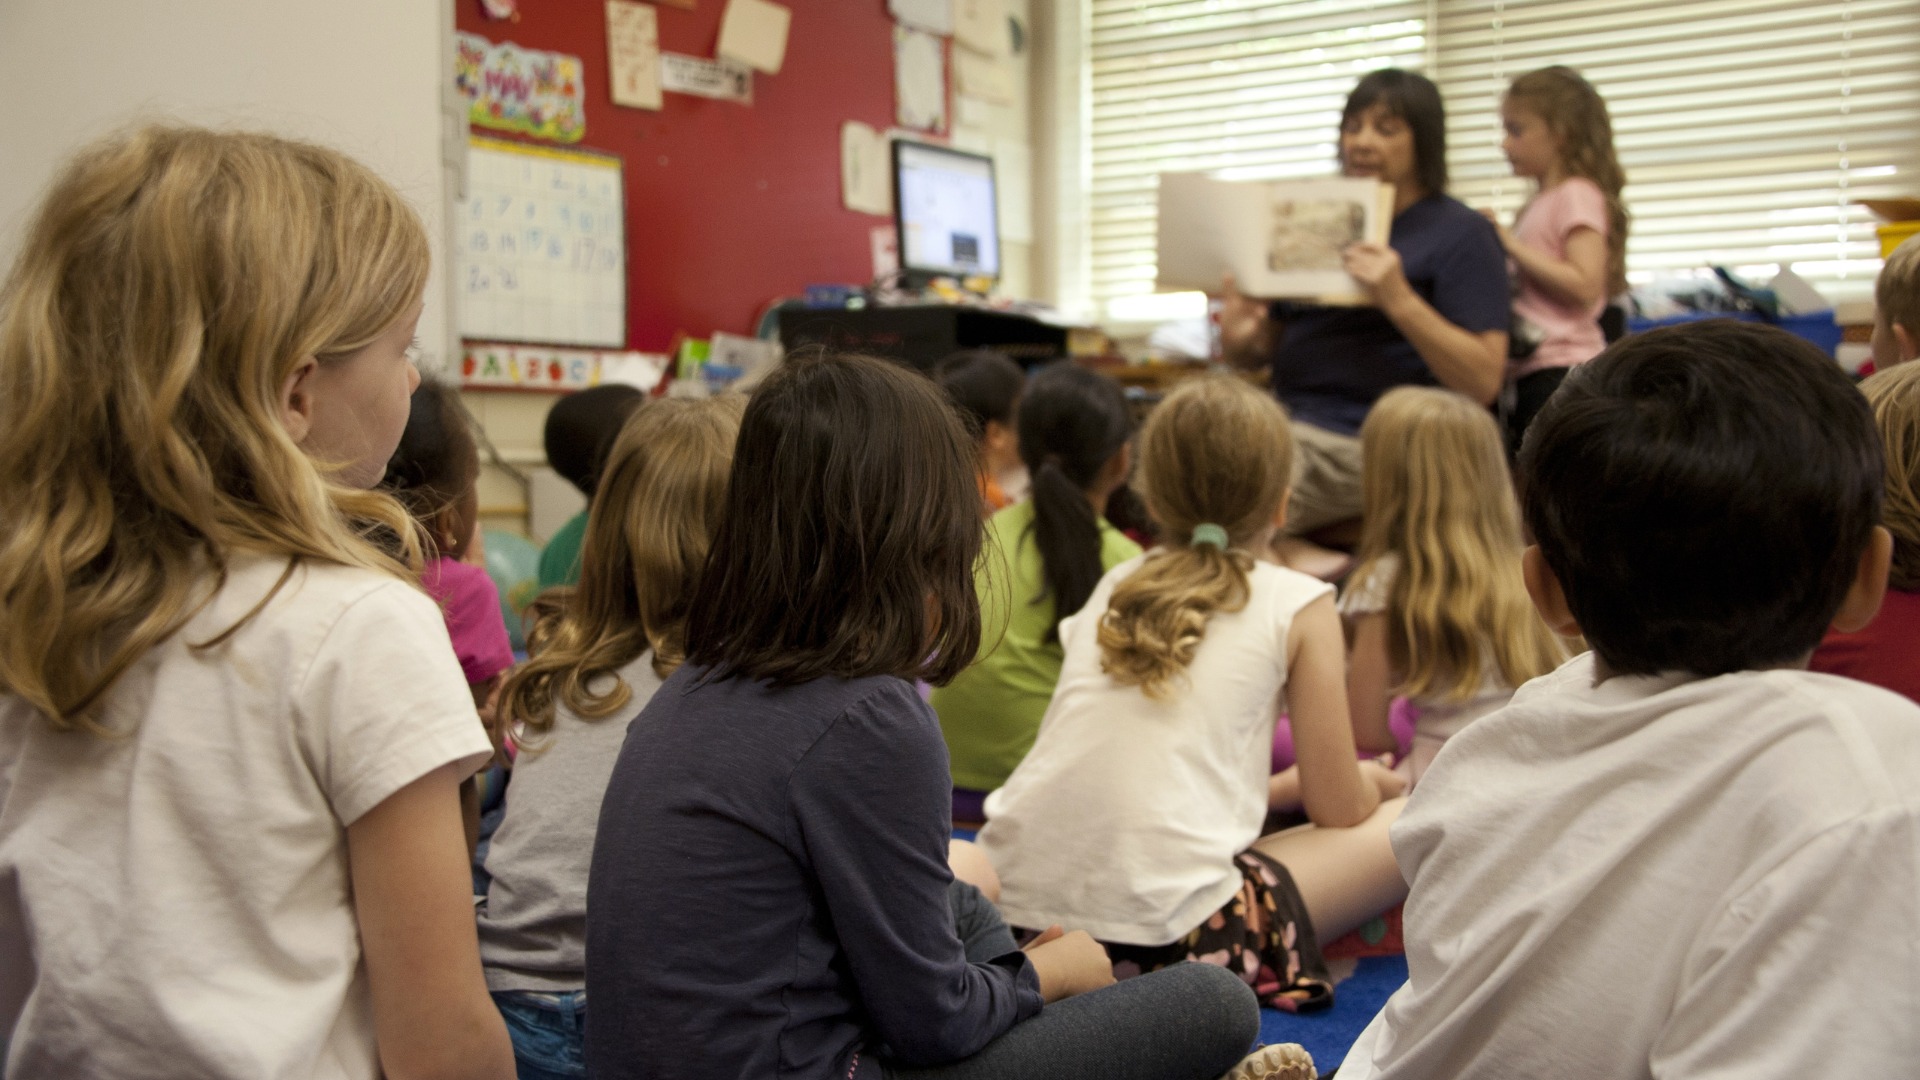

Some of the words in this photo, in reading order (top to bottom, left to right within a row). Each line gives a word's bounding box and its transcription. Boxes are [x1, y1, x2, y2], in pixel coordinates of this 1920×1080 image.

[485, 69, 534, 102] MAY
[571, 237, 596, 273] 17
[482, 353, 500, 377] A
[528, 357, 541, 380] B
[569, 359, 587, 381] C
